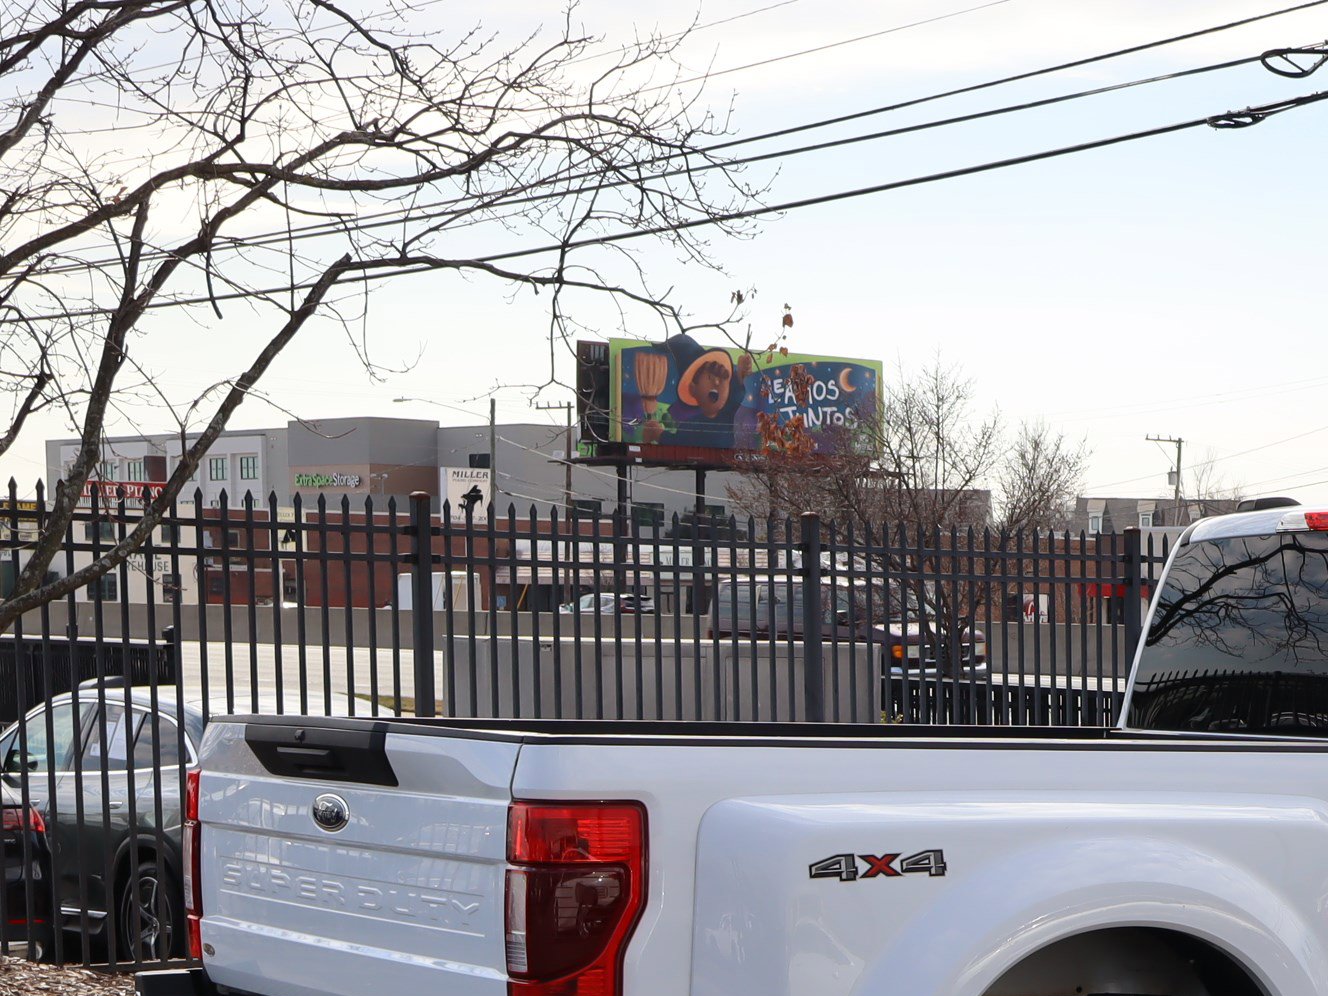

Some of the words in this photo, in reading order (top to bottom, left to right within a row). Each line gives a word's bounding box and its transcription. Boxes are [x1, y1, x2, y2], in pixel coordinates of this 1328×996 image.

[452, 470, 489, 479] MILLER
[223, 864, 345, 905] SUPER
[358, 885, 480, 926] DUTY
